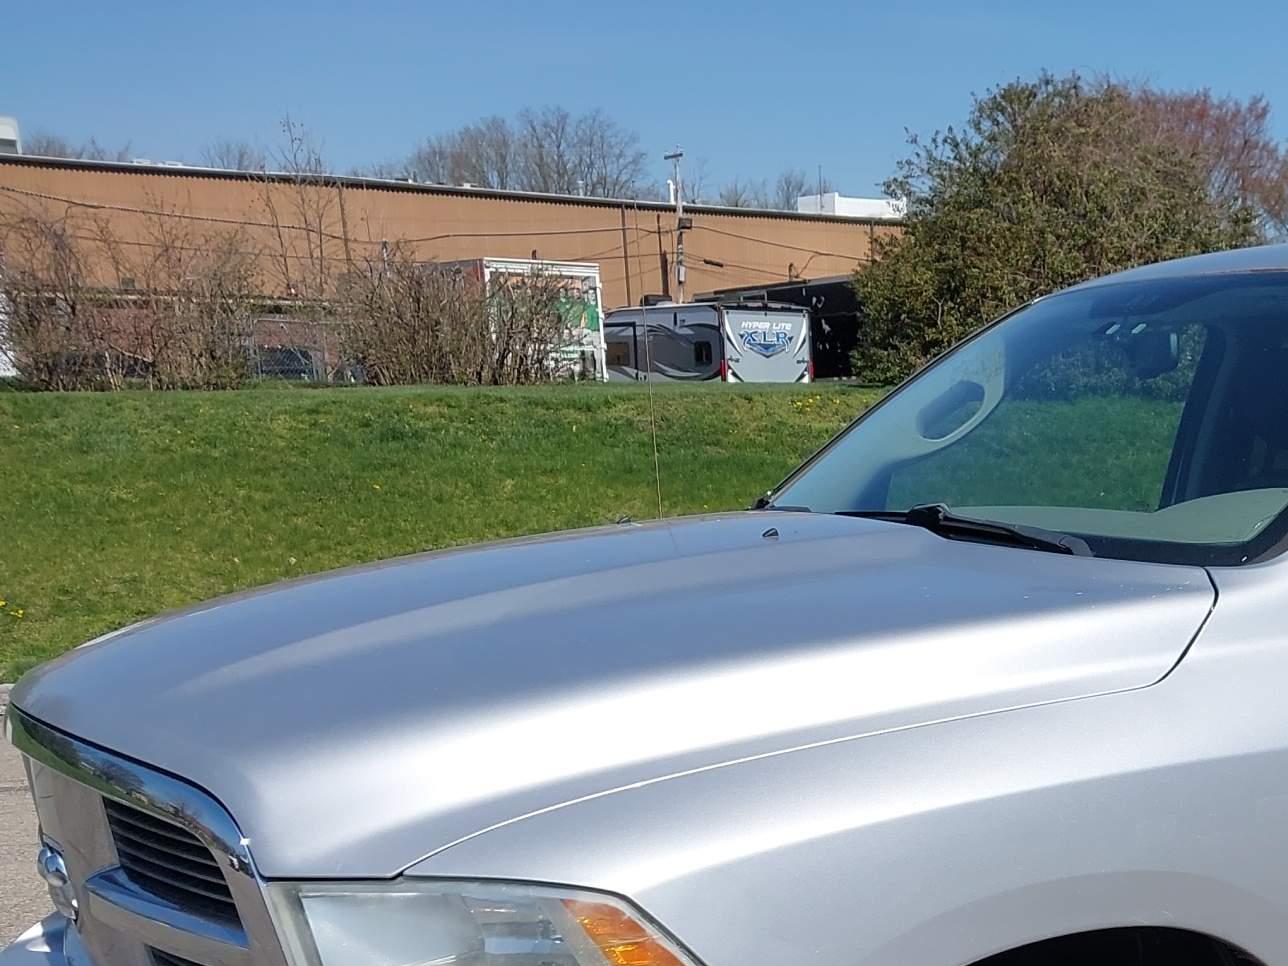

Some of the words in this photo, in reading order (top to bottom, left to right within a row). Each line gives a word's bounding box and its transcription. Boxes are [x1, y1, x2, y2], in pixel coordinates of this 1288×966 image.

[741, 321, 770, 329] HYPER
[773, 322, 792, 331] LITE
[743, 329, 791, 352] XLR
